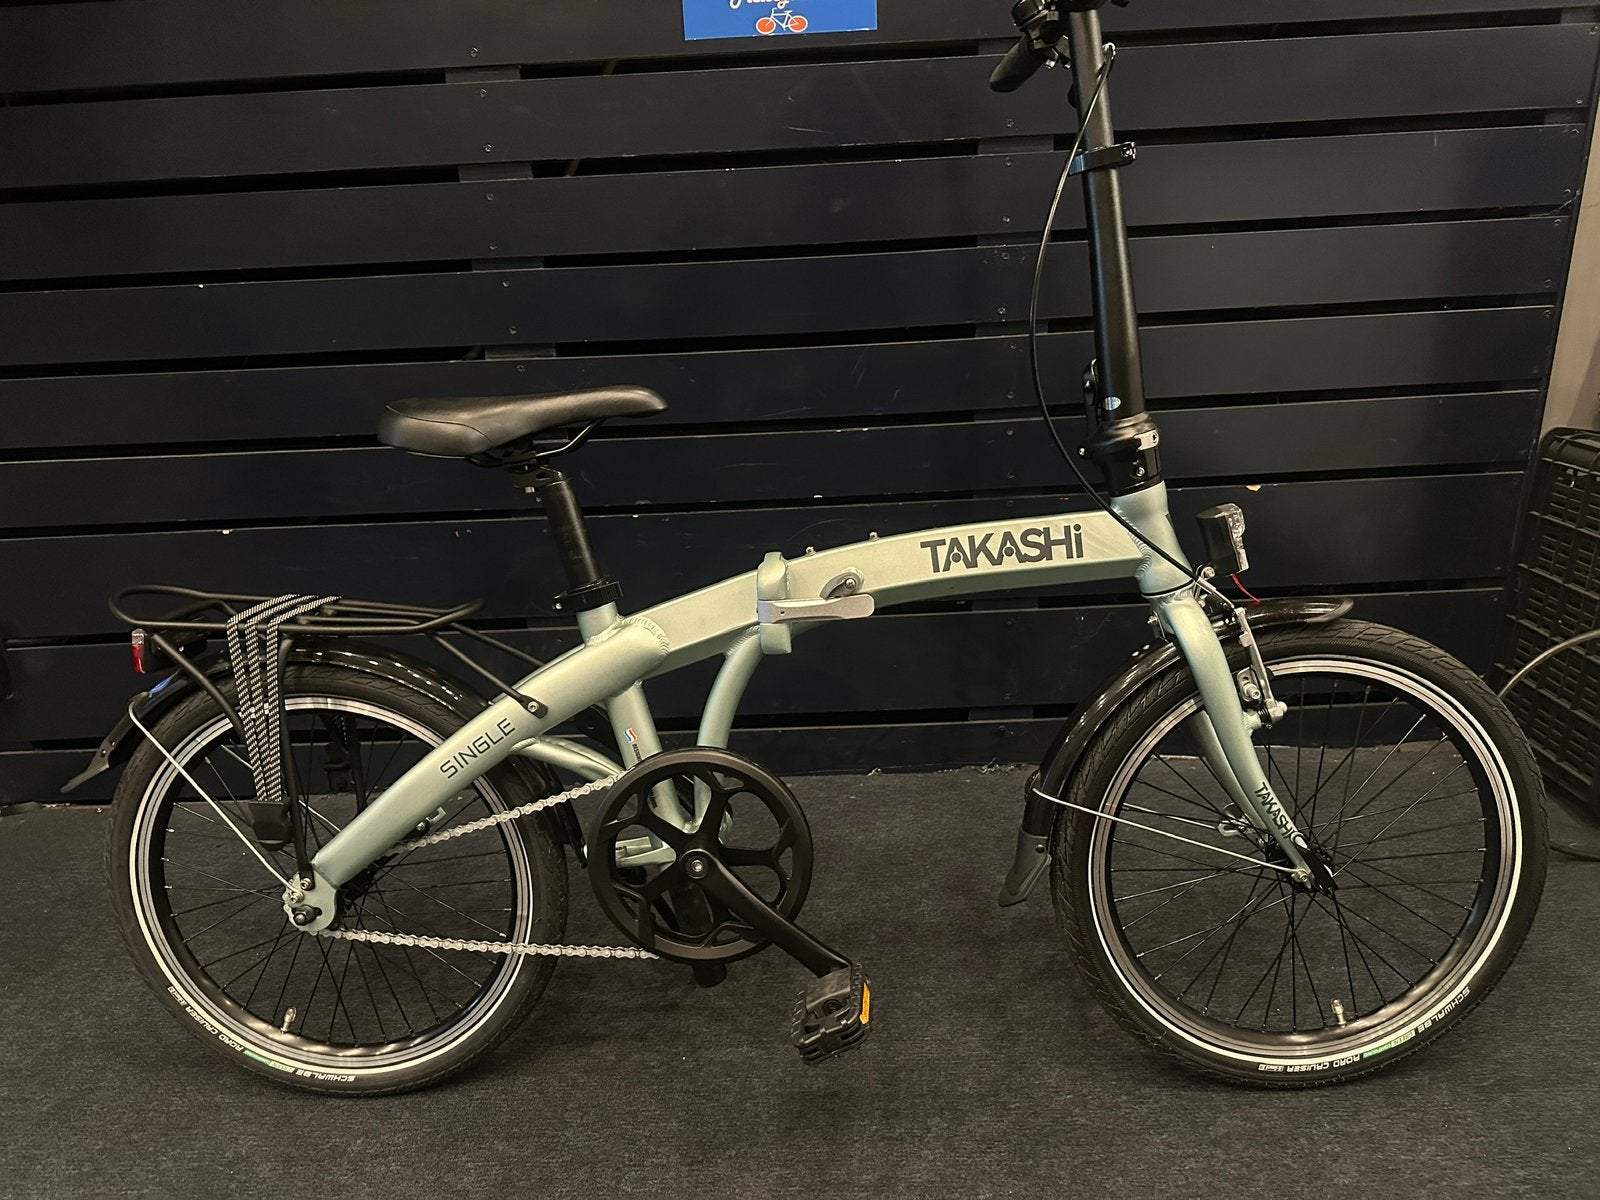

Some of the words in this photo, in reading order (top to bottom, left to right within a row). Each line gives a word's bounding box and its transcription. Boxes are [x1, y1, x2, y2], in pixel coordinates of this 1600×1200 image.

[920, 523, 1084, 573] TAKASHi
[440, 717, 516, 779] SINGLE
[185, 1006, 218, 1036] CRUISER
[1417, 986, 1471, 1033] SCHWALBE
[219, 1034, 244, 1052] ROAD
[1286, 1061, 1330, 1073] CRUISER
[1333, 1054, 1361, 1068] ROAD
[296, 1067, 356, 1082] SCHWALBE
